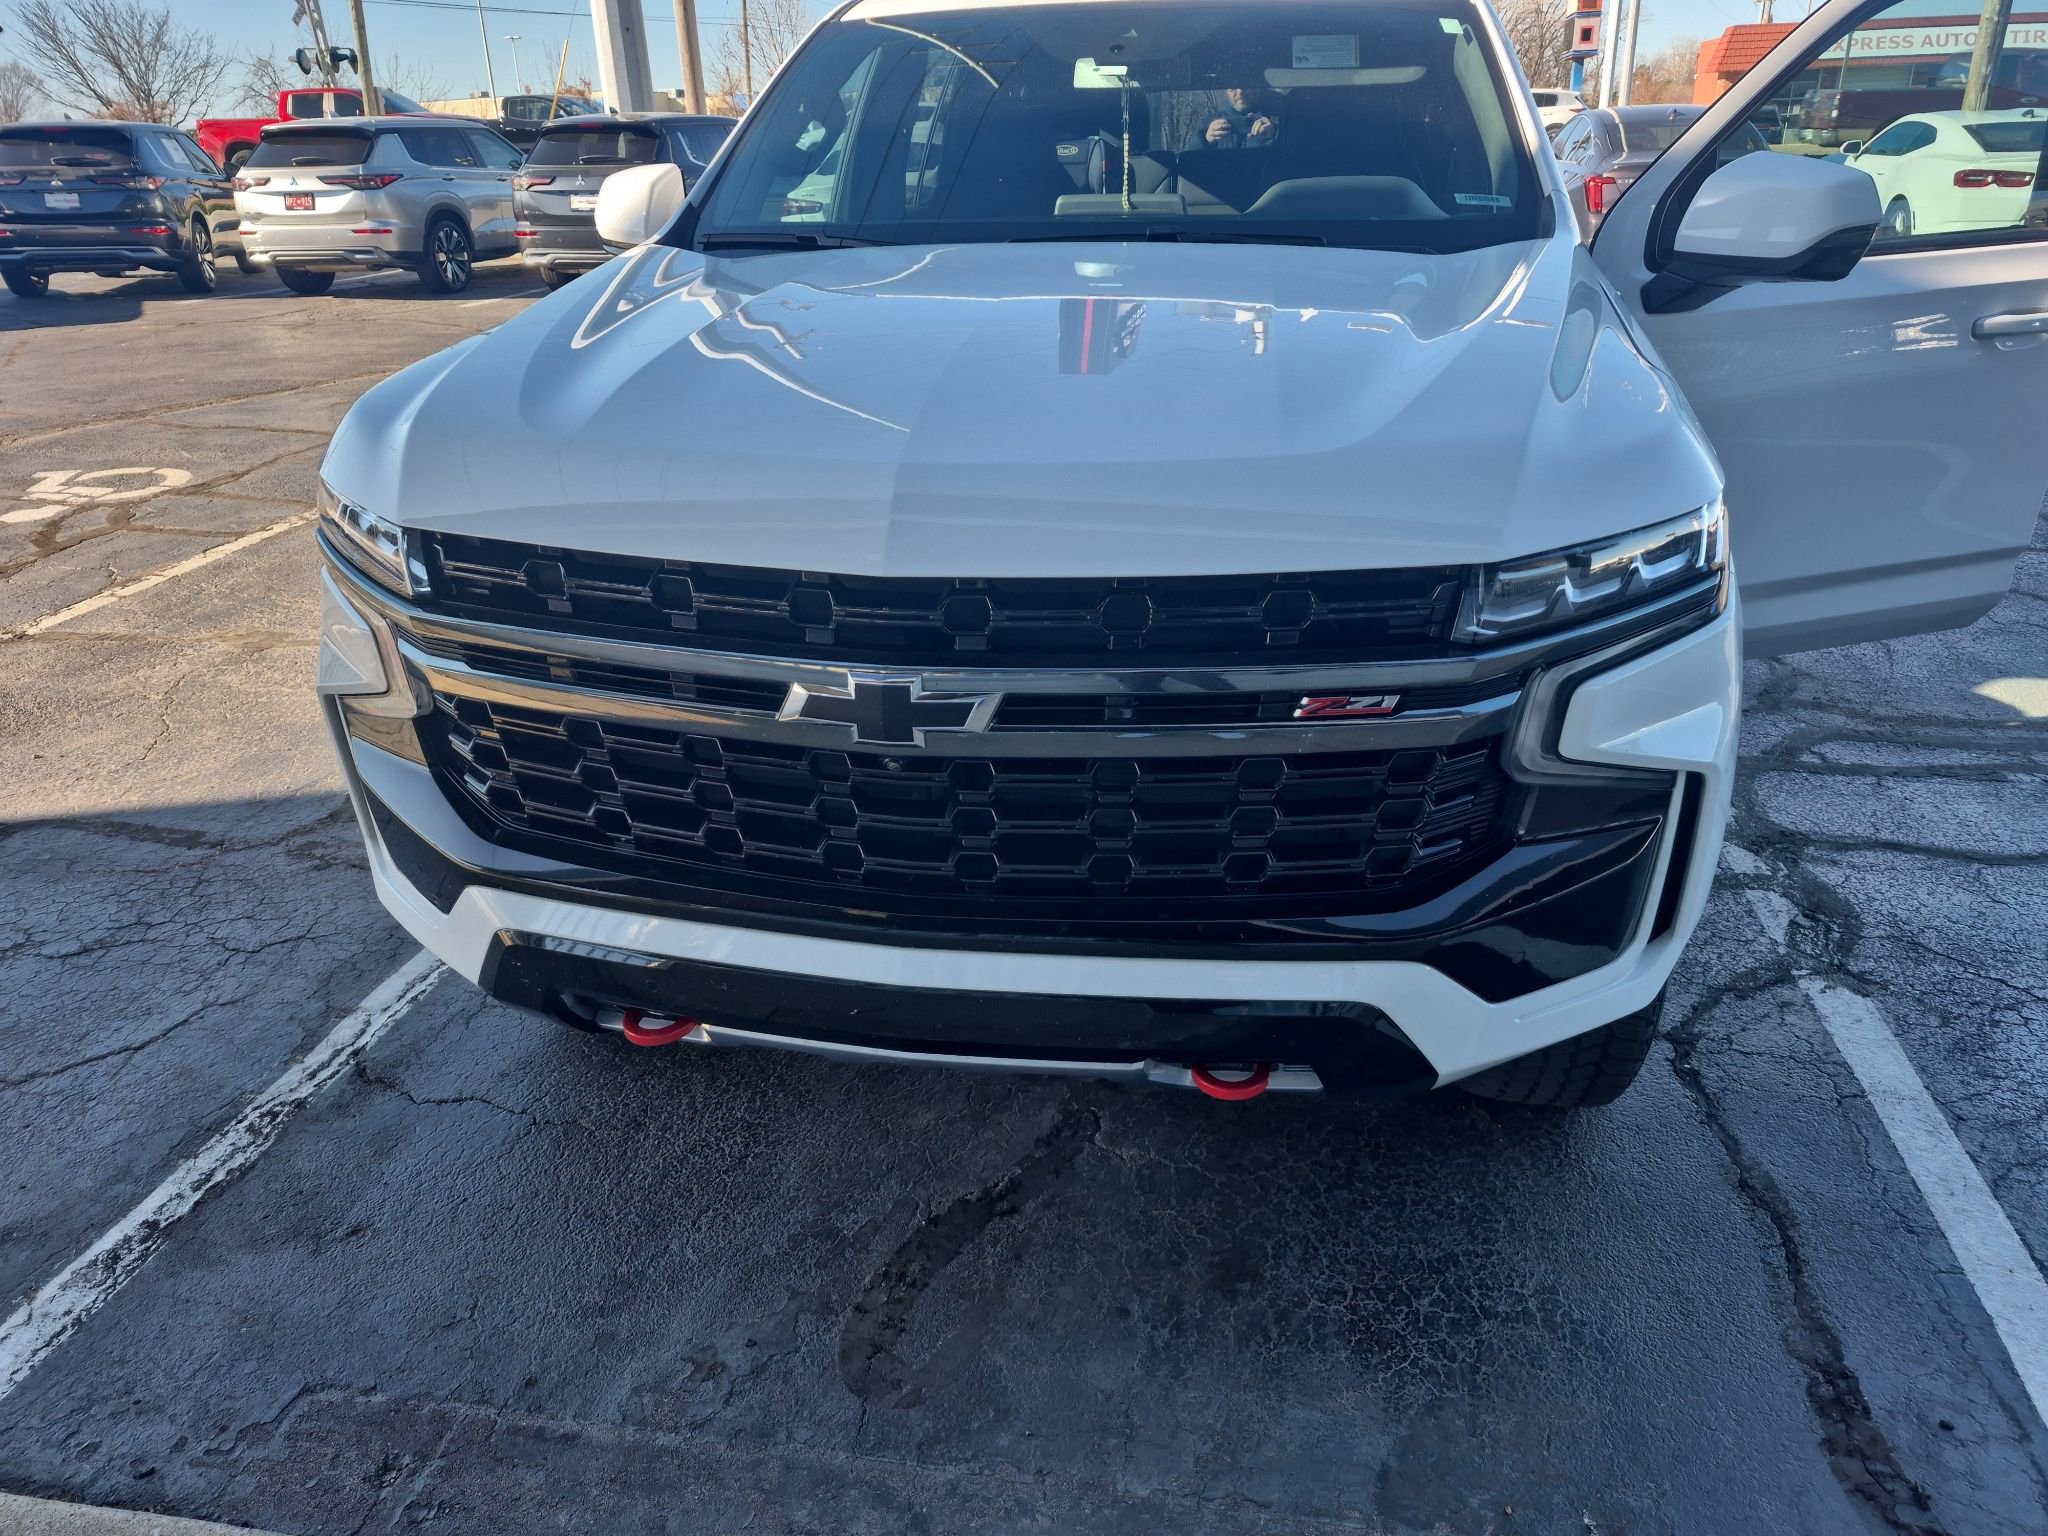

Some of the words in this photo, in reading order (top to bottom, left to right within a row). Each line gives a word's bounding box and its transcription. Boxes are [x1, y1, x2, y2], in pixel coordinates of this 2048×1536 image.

[1827, 35, 1914, 52] XPRESS
[1920, 32, 1979, 48] AUTO
[1293, 695, 1400, 717] Z71
